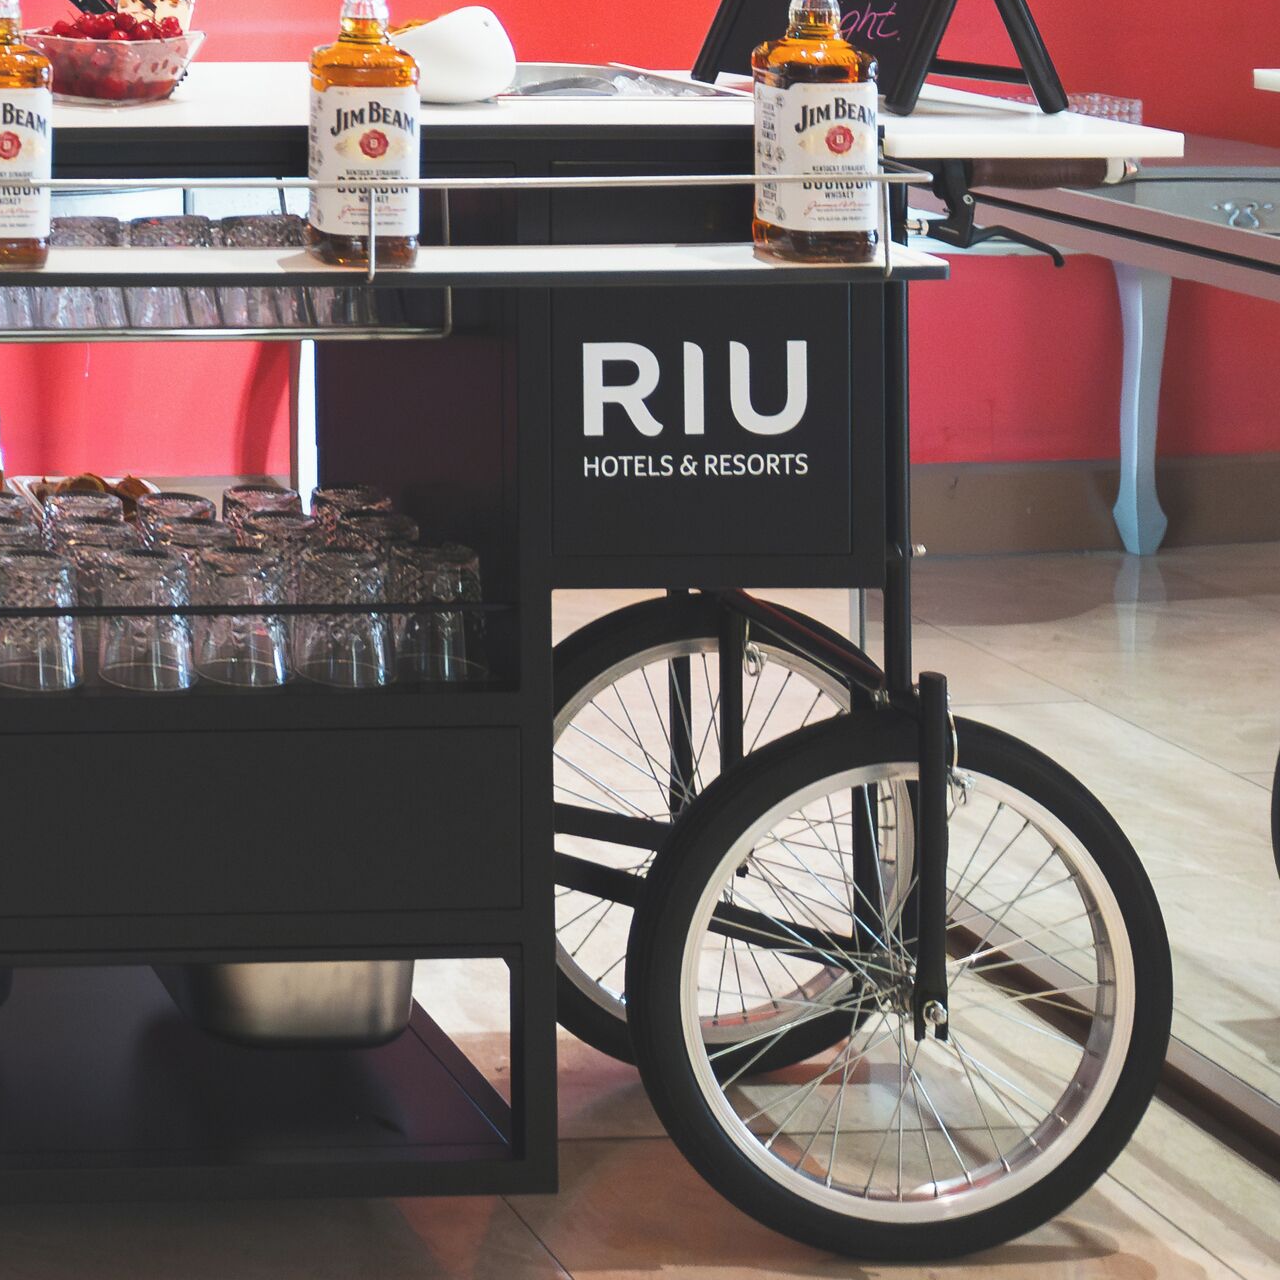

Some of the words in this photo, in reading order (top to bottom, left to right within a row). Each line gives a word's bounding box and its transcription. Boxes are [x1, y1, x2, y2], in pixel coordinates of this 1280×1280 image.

[2, 103, 47, 137] BEAM
[330, 108, 365, 136] JIM
[368, 101, 414, 136] BEAM
[794, 104, 831, 133] JIM
[834, 97, 876, 130] BEAM
[583, 340, 808, 437] RIU
[583, 455, 674, 478] HOTELS
[679, 455, 699, 477] &
[704, 453, 809, 476] RESORTS
